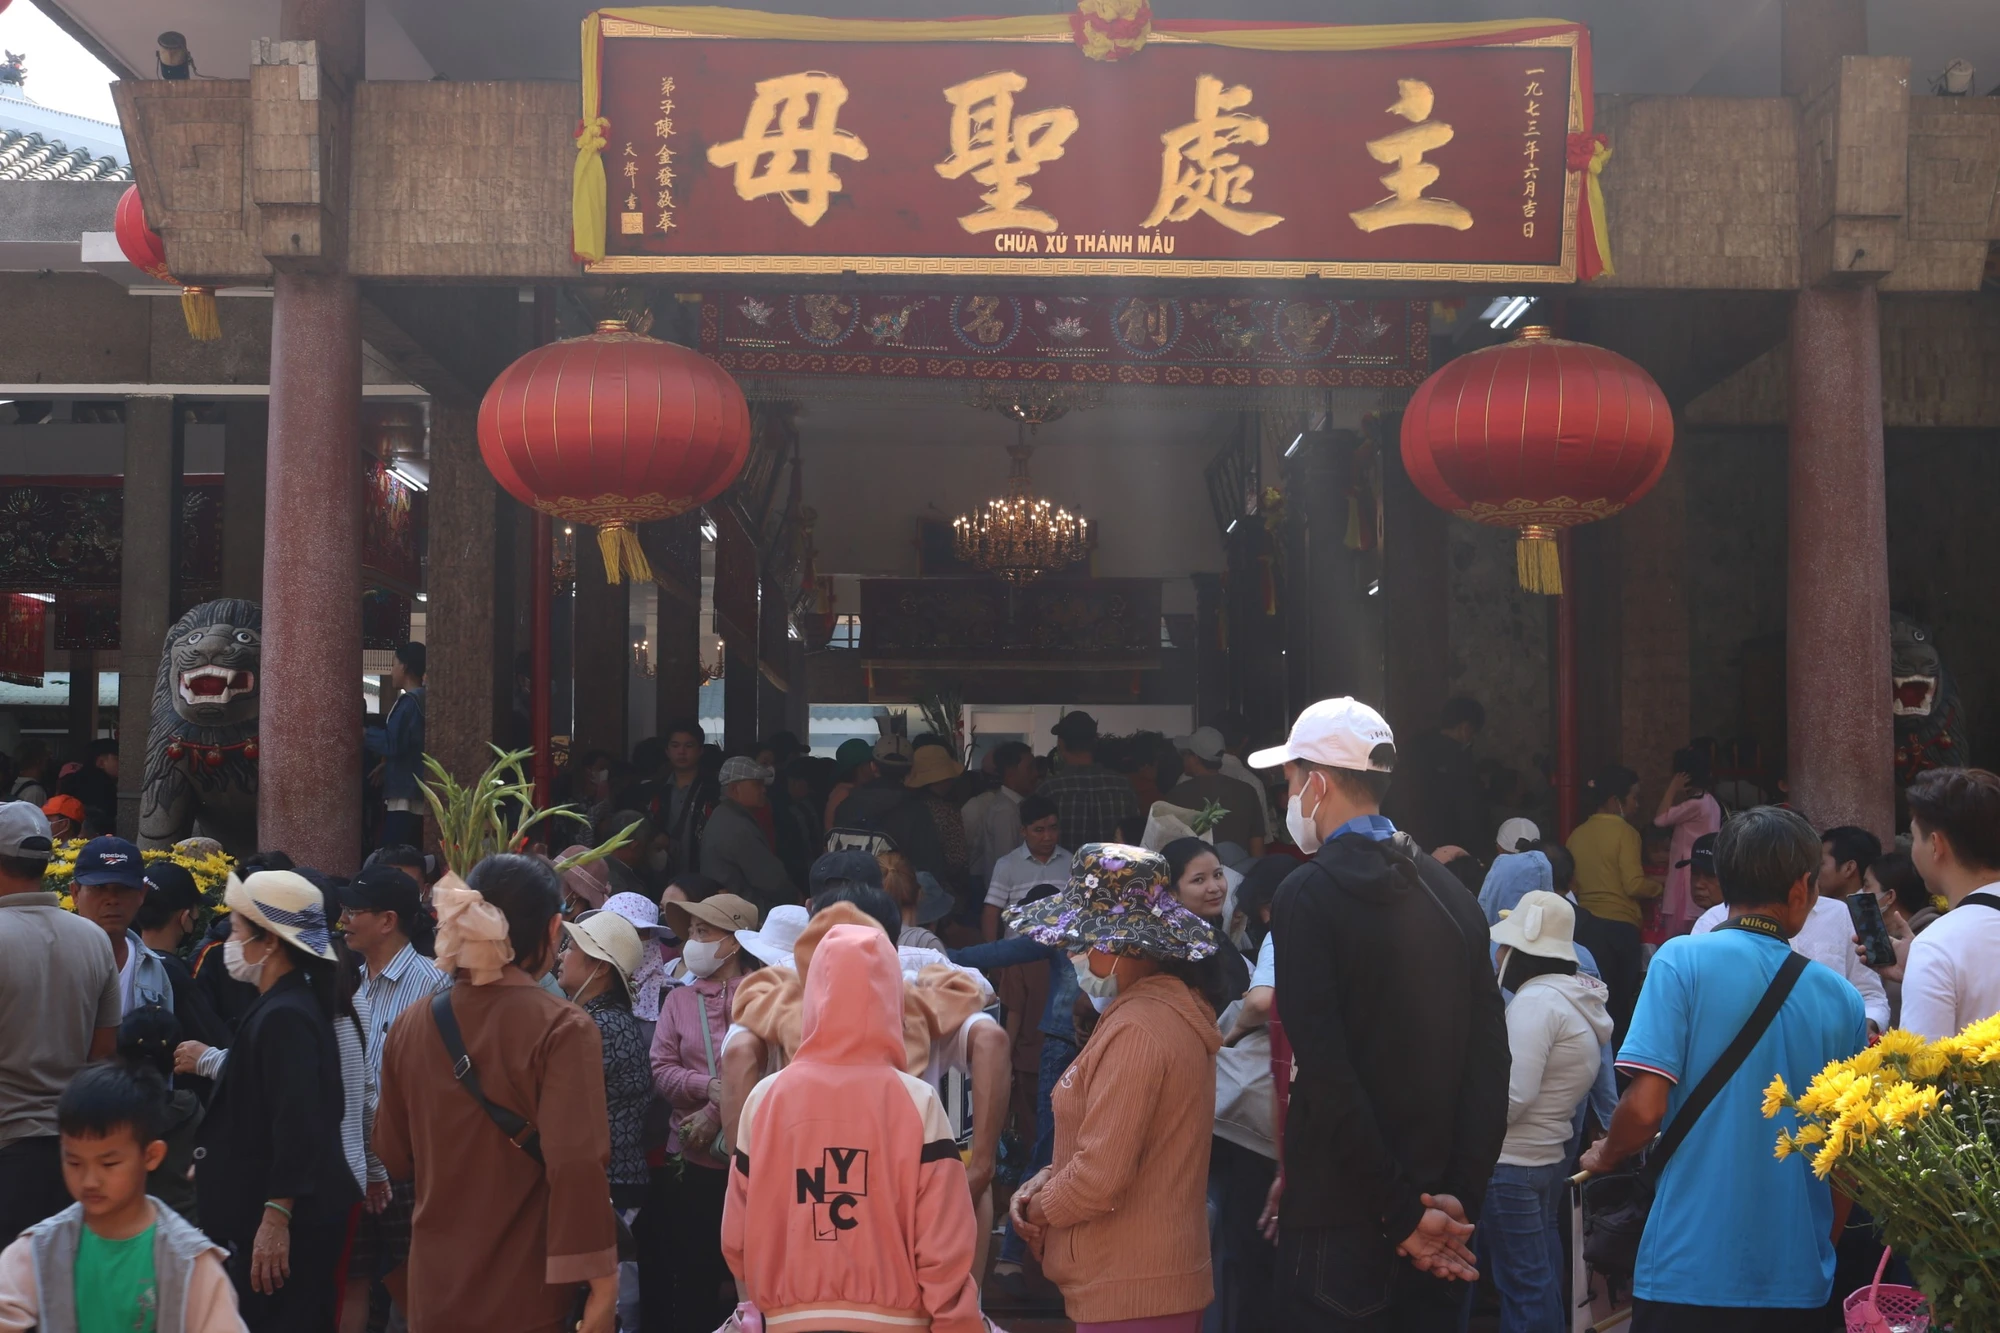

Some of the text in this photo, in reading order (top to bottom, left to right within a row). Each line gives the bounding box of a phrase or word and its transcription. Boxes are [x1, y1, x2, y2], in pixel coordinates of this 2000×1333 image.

[1522, 67, 1545, 238] 一九七三年六月吉日
[994, 230, 1175, 254] CHÚA XỨ THÁNH MẪU
[1740, 917, 1777, 932] Nikon
